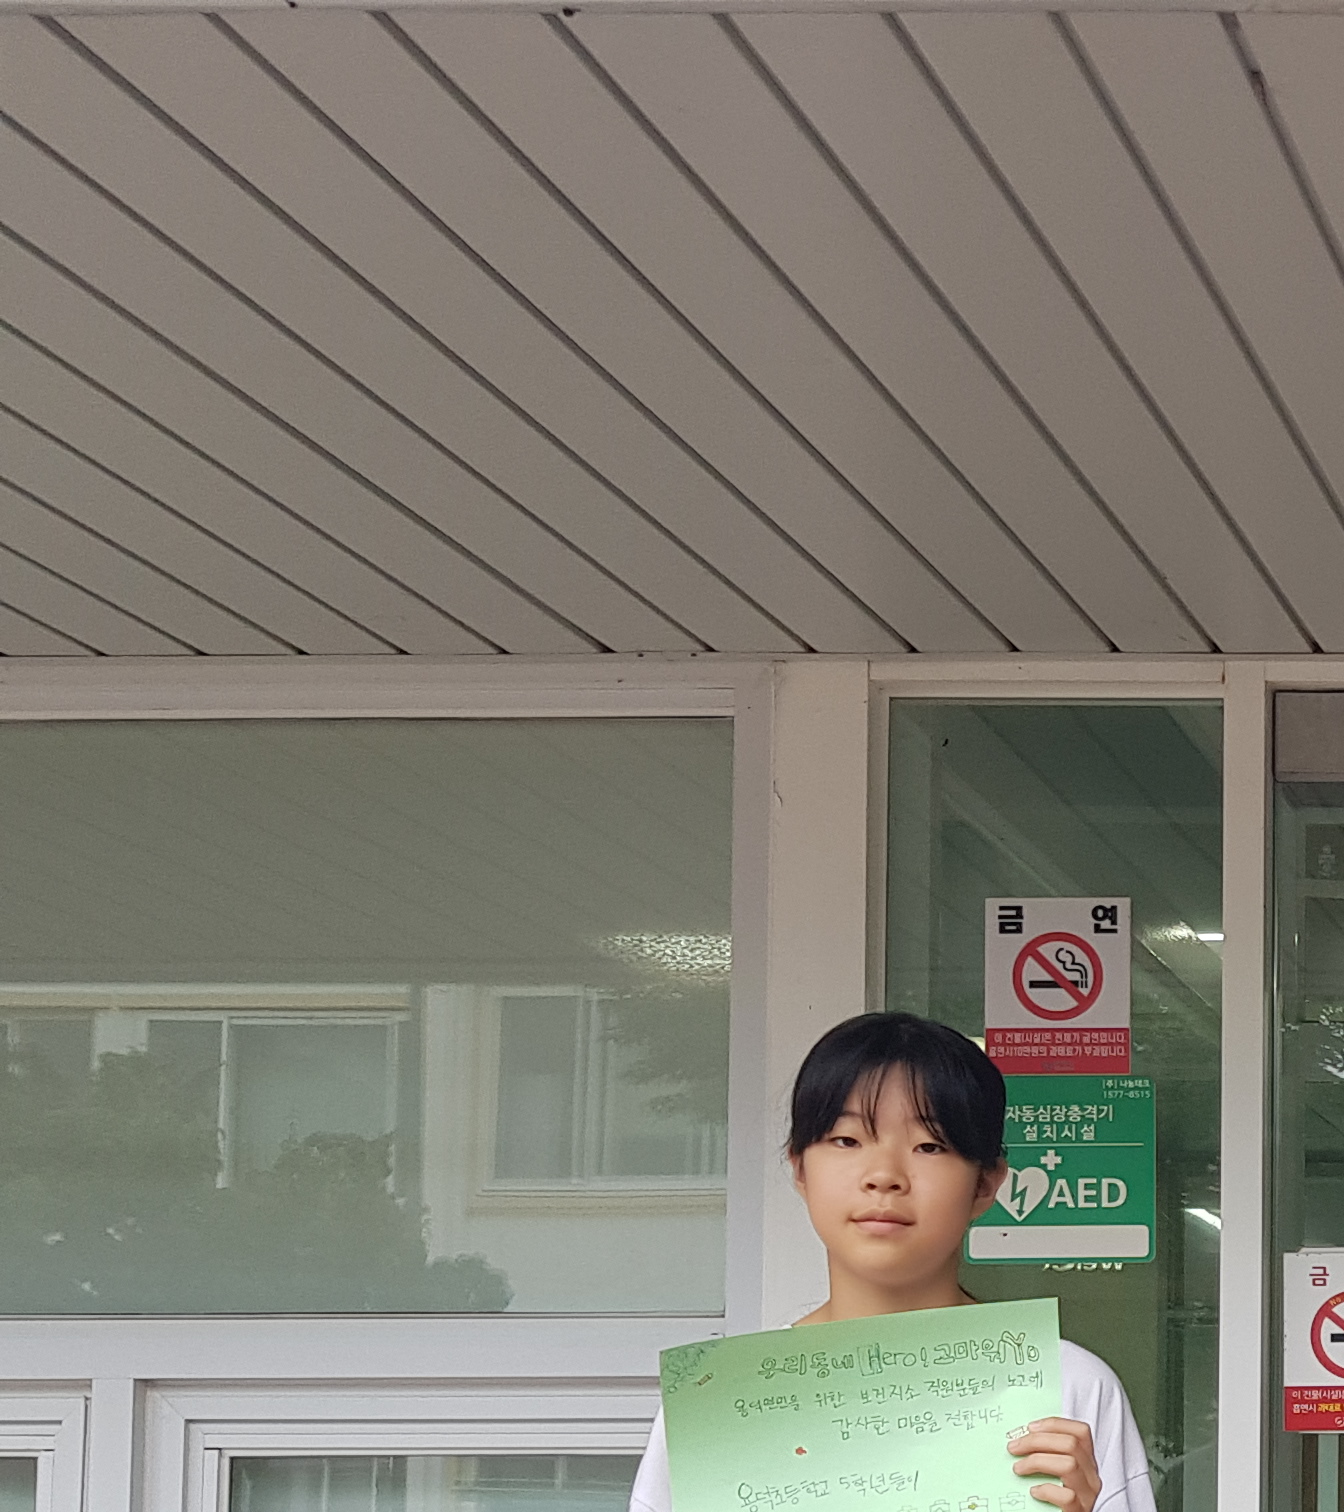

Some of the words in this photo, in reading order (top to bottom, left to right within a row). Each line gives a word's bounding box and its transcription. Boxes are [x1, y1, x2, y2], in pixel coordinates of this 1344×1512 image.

[1005, 1104, 1114, 1122] 자동심장충격기
[1022, 1124, 1096, 1142] 설치시설
[1047, 1177, 1128, 1209] AED
[757, 1353, 854, 1379] 우리동네
[860, 1383, 921, 1405] 보건지소
[923, 1377, 996, 1399] 직원분들의
[1007, 1370, 1044, 1389] 노고에
[1292, 1390, 1301, 1400] 이
[831, 1415, 890, 1441] 감사한
[897, 1411, 941, 1433] 마음을
